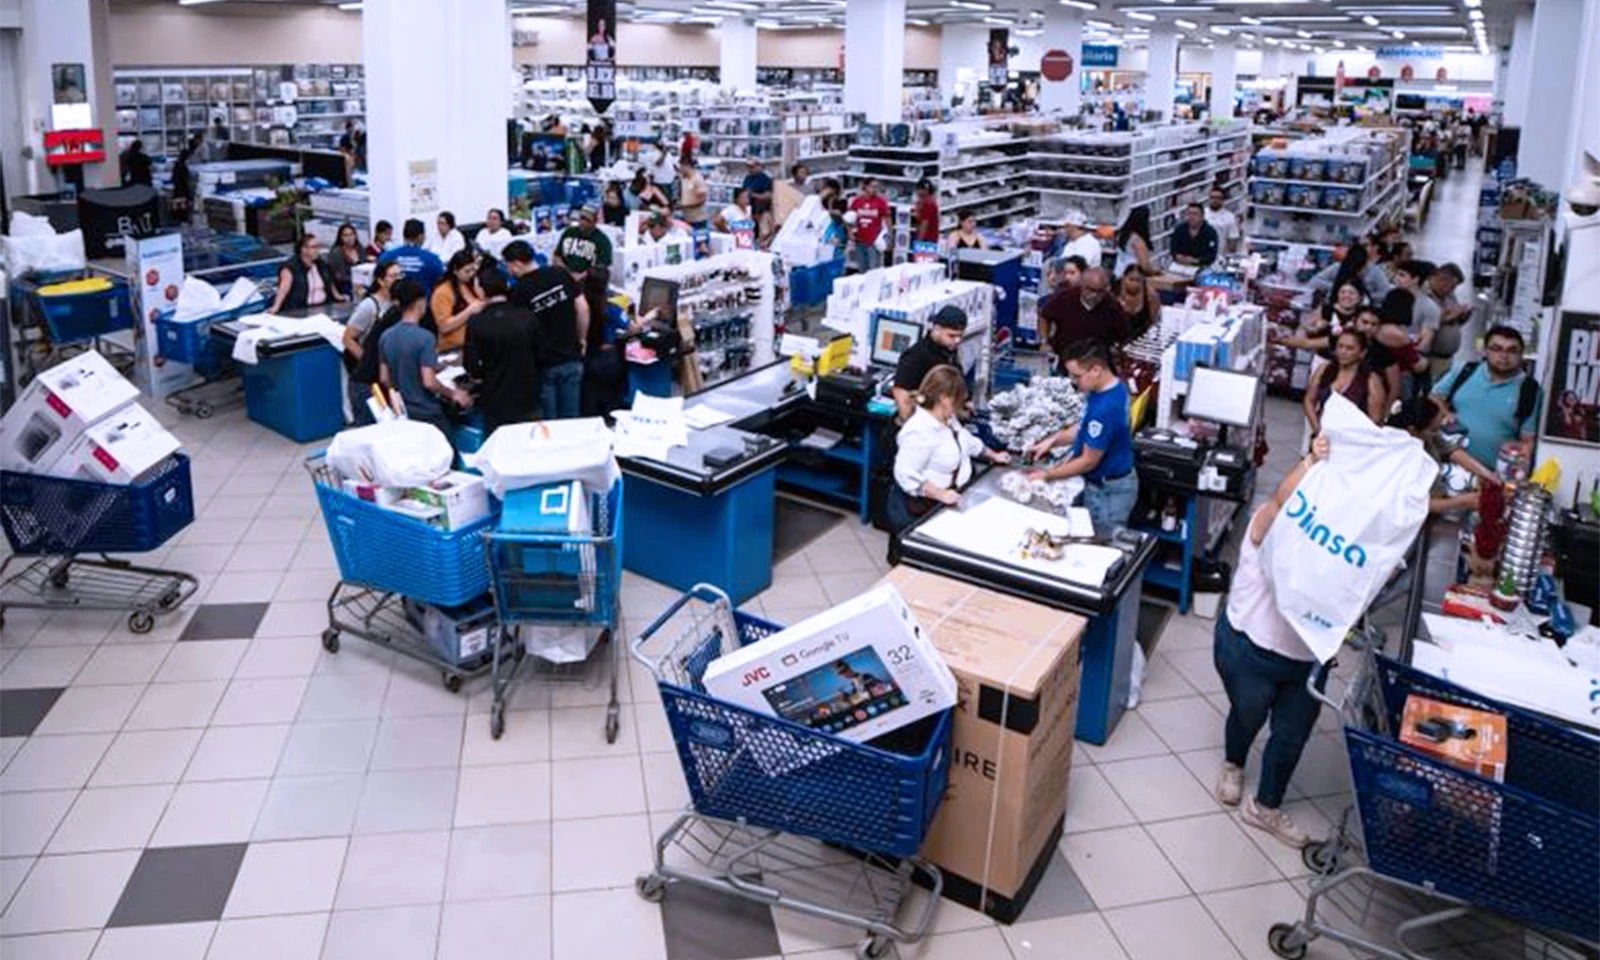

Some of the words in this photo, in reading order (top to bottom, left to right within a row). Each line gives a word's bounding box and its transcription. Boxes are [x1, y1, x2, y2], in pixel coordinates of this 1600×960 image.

[799, 639, 835, 660] Google
[834, 631, 850, 646] TV
[887, 644, 916, 665] 32
[742, 666, 771, 687] JVC
